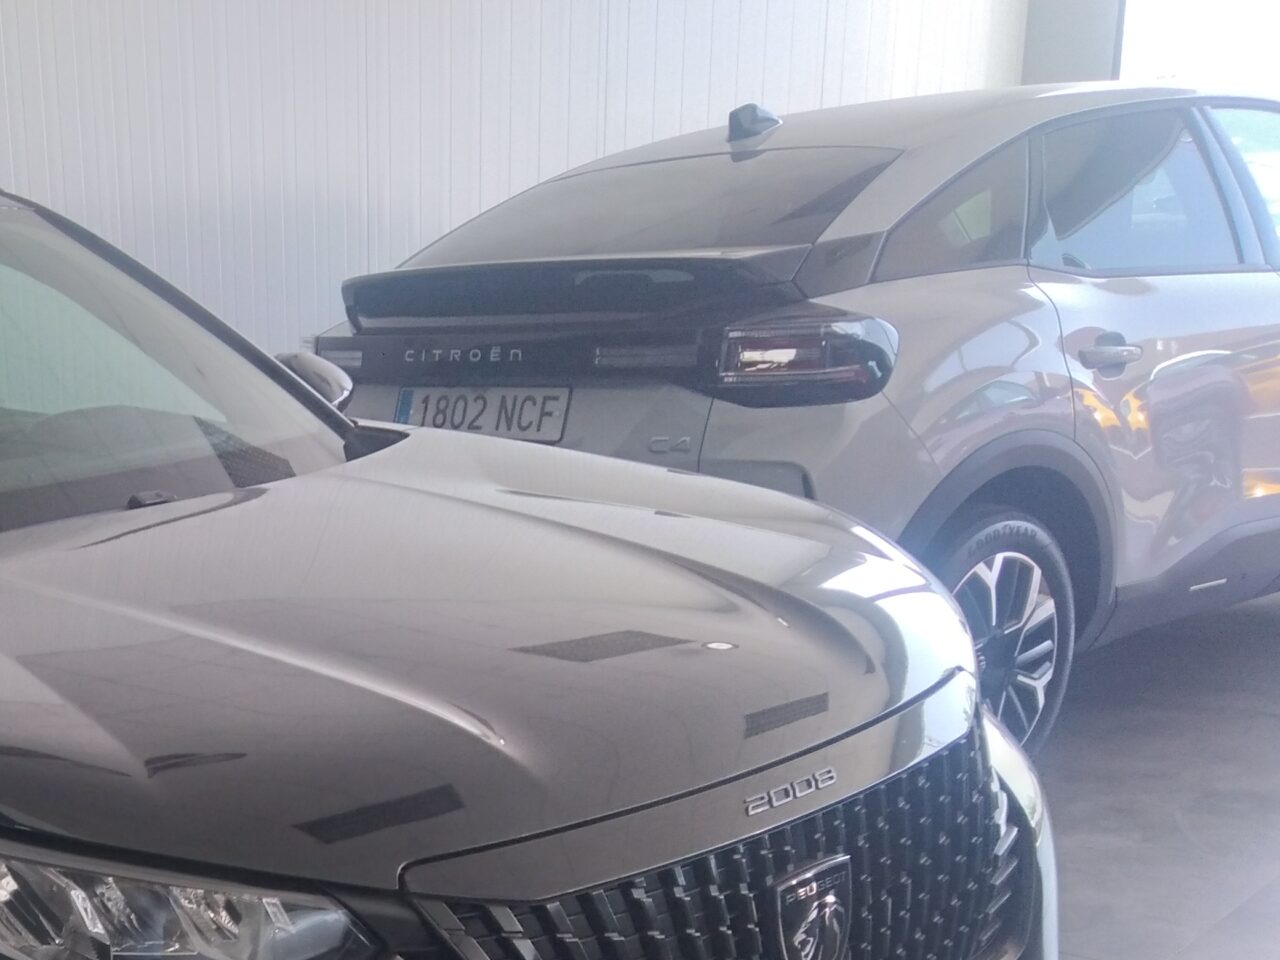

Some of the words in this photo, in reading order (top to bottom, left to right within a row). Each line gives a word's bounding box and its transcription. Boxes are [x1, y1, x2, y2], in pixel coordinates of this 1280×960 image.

[404, 346, 523, 362] CITROËN
[421, 394, 487, 430] 1802
[495, 394, 560, 432] NCF
[744, 766, 837, 816] 2008
[785, 871, 847, 904] PEUGEOT
